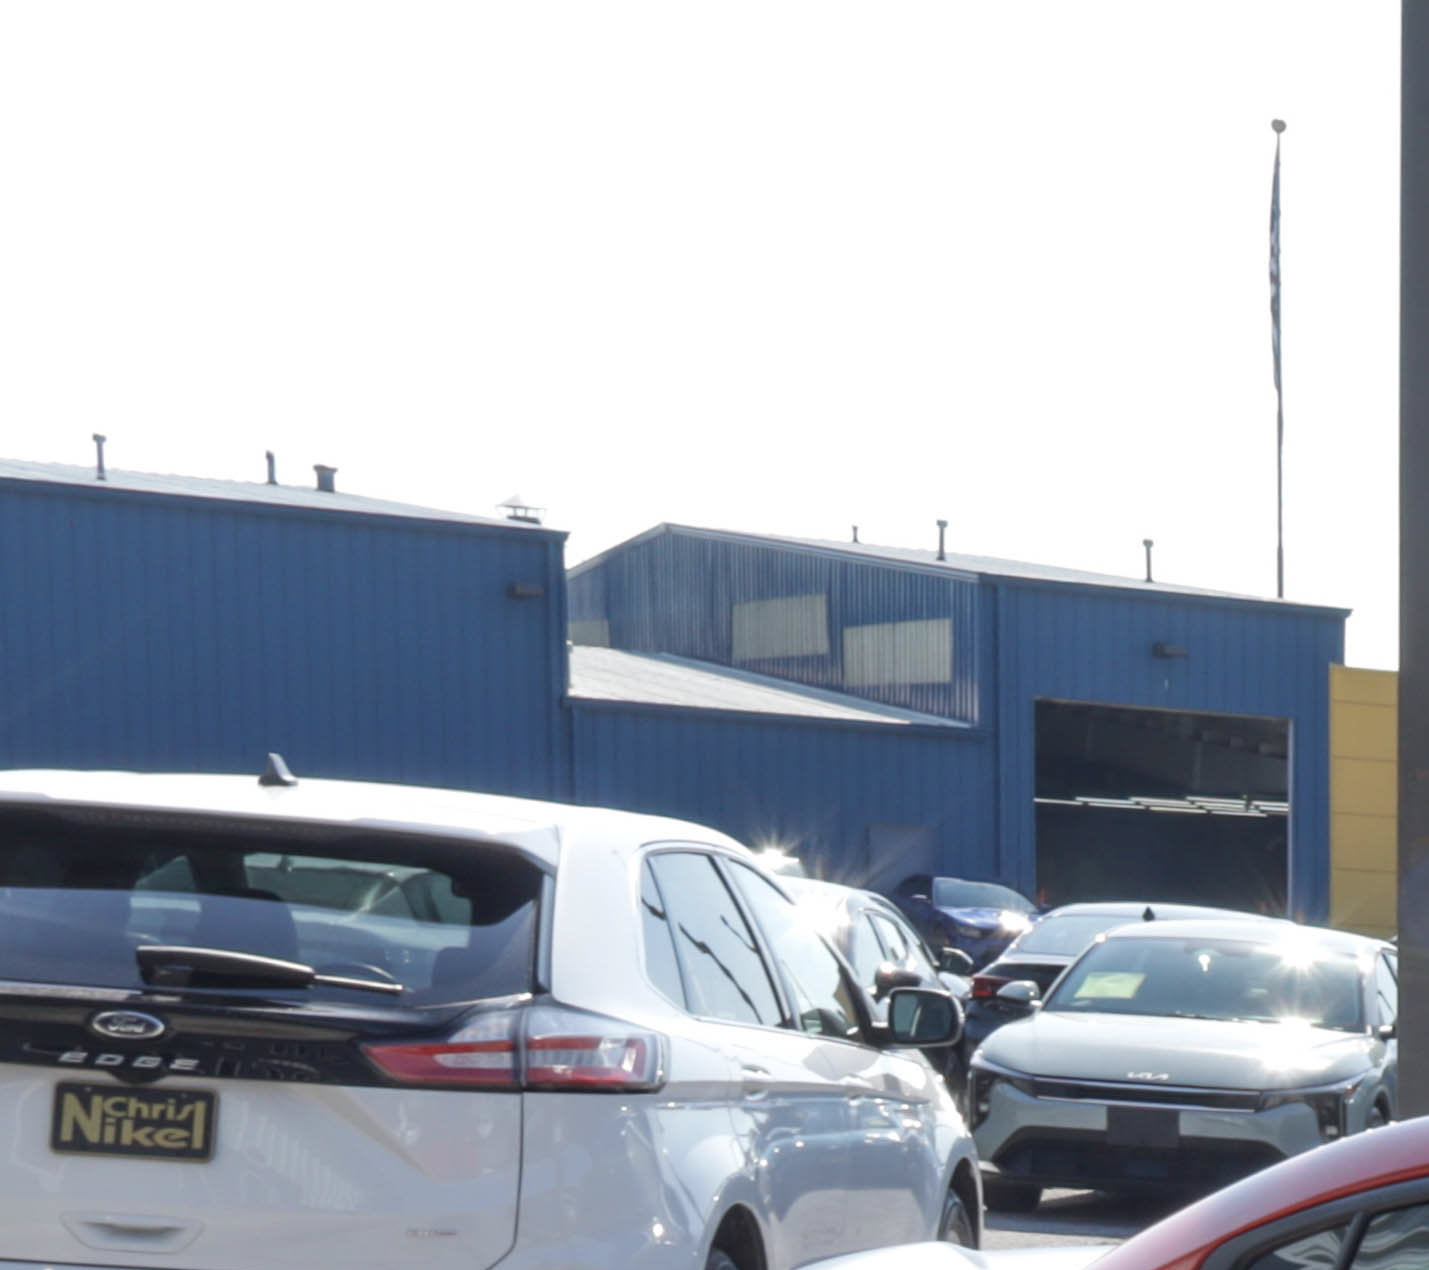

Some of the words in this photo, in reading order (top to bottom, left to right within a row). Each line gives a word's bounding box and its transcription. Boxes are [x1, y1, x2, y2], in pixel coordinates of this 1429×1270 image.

[58, 1051, 200, 1071] EDGE
[103, 1096, 194, 1120] Chris
[60, 1092, 207, 1149] Nikel
